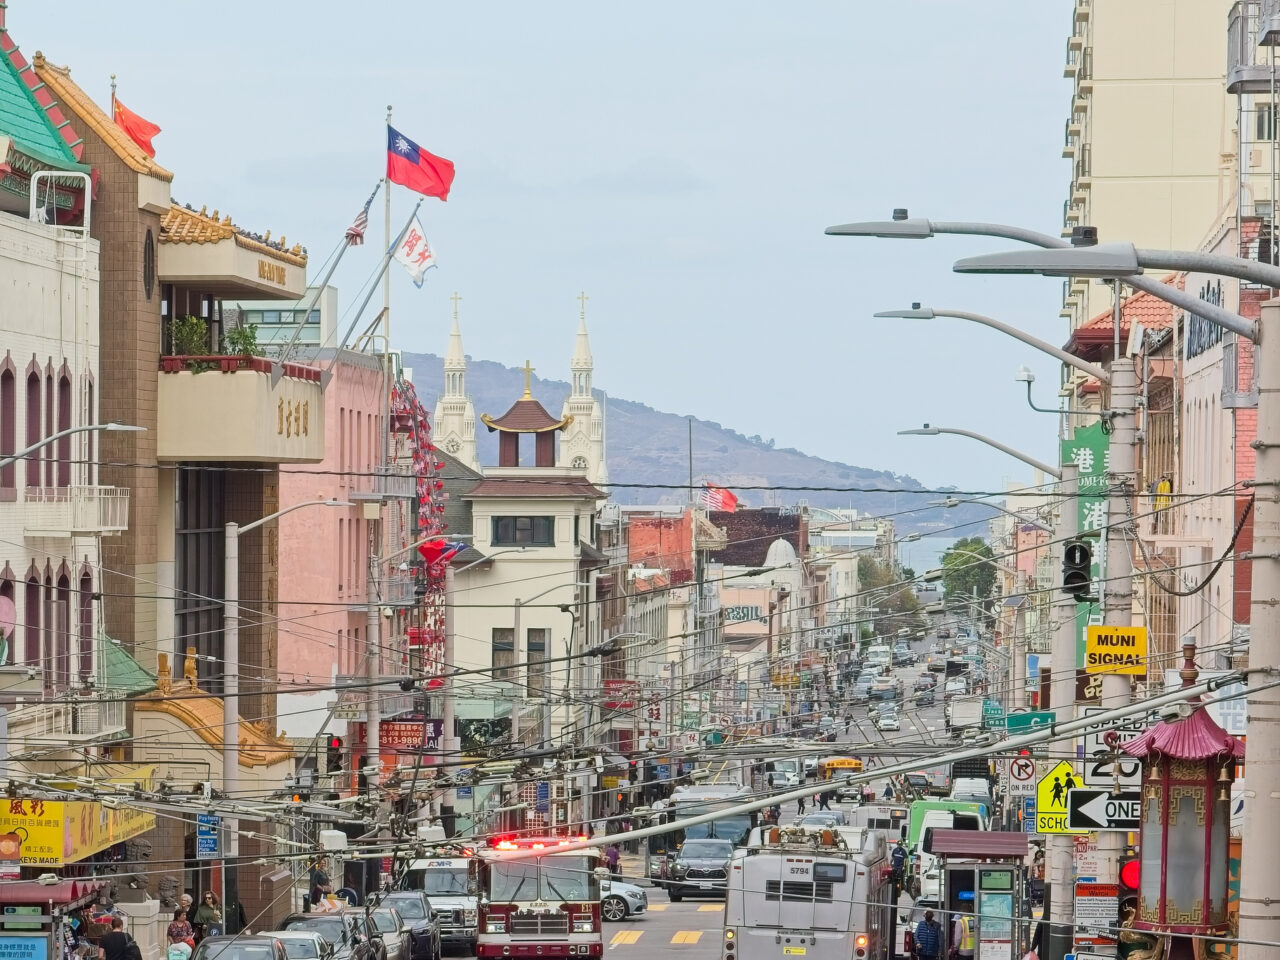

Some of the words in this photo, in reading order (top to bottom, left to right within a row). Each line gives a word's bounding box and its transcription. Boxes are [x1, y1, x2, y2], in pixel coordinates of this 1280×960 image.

[1097, 635, 1136, 647] MUNI
[1088, 653, 1145, 665] SIGNAL
[1091, 749, 1140, 778] 20
[1105, 802, 1140, 818] ONE
[19, 856, 37, 864] KEYS
